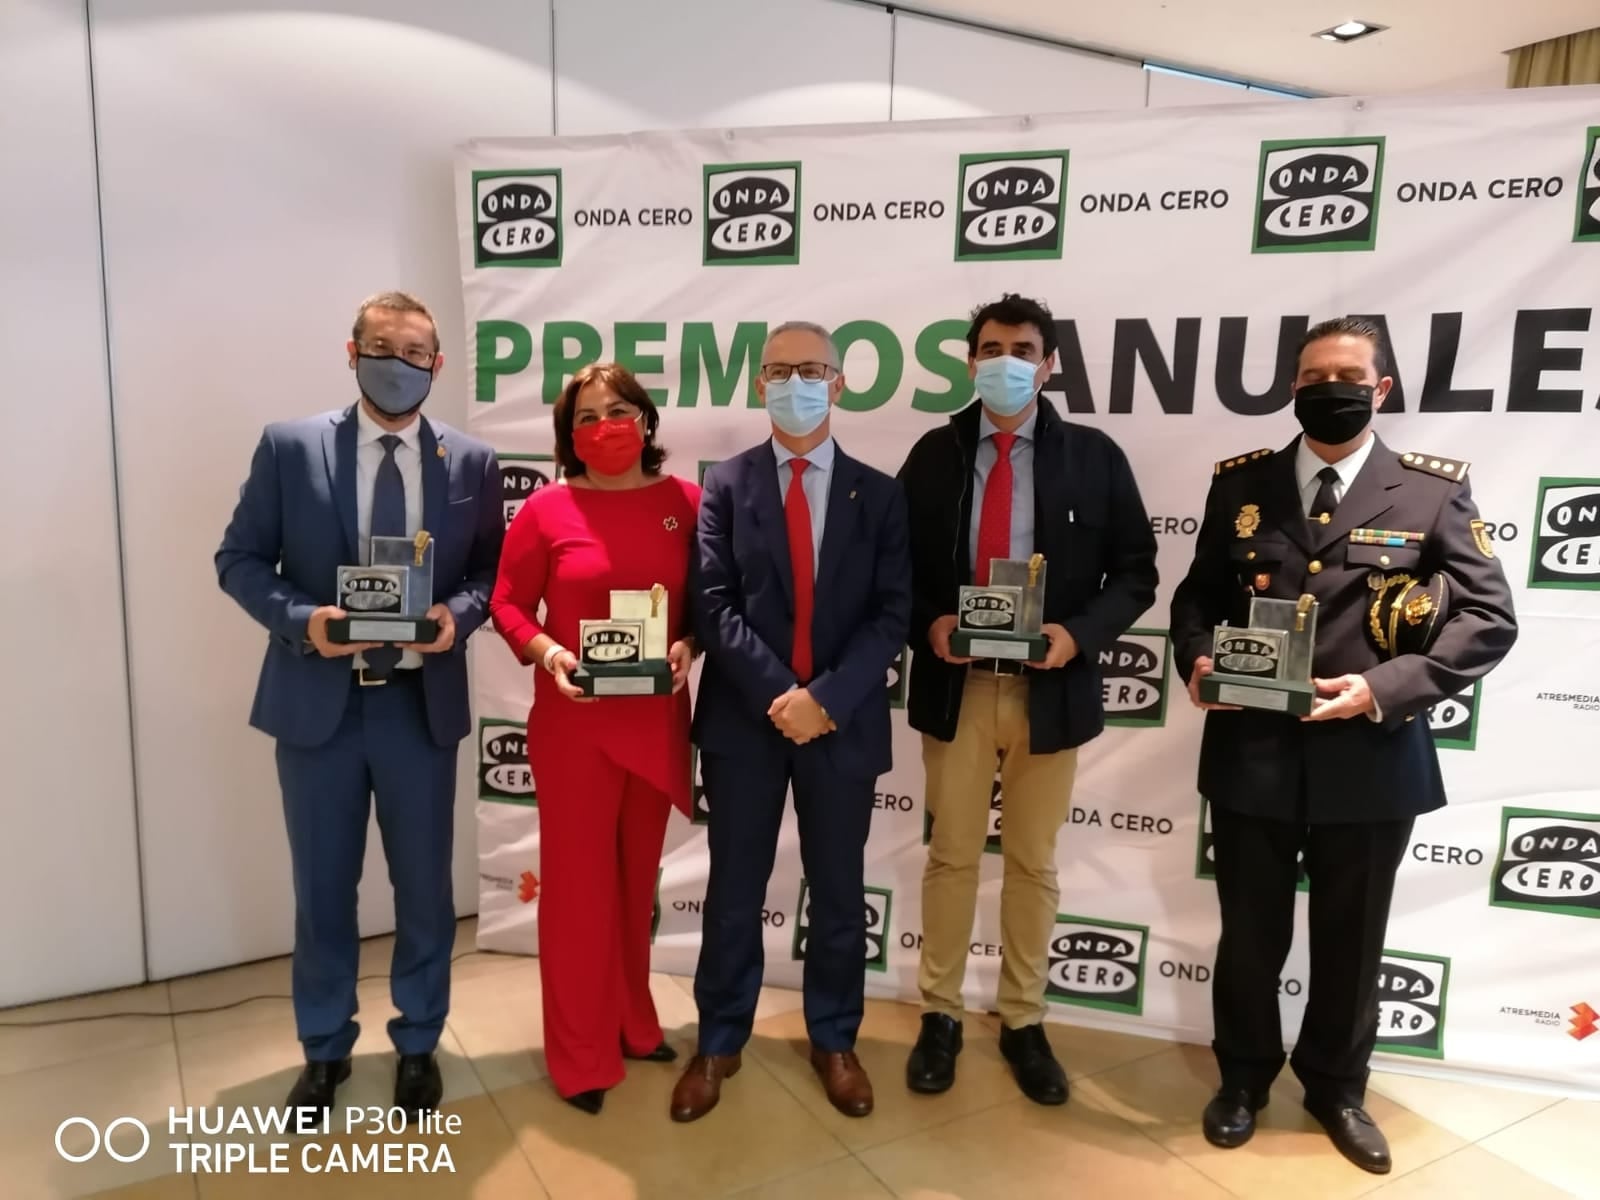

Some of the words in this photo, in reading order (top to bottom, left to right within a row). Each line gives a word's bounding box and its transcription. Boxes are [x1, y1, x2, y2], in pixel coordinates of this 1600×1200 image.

[1278, 165, 1359, 188] ONDA
[719, 187, 783, 208] ONDA
[975, 178, 1047, 200] ONDA
[1397, 181, 1478, 203] ONDA
[1487, 176, 1564, 199] CERO
[487, 193, 546, 213] ONDA
[813, 202, 877, 222] ONDA
[884, 200, 945, 220] CERO
[1079, 192, 1151, 213] ONDA
[1160, 189, 1229, 211] CERO
[573, 208, 631, 227] ONDA
[637, 208, 694, 227] CERO
[977, 214, 1045, 238] CERO
[1279, 203, 1356, 228] CERO
[492, 226, 545, 247] CERO
[722, 222, 782, 243] CERO
[475, 318, 977, 412] PREMOS
[503, 474, 545, 491] NDA
[1151, 516, 1198, 535] ERO
[1557, 505, 1598, 526] ON
[1484, 522, 1518, 541] RO
[1557, 543, 1600, 565] CE
[1098, 650, 1150, 669] NDA
[1102, 684, 1148, 705] ERO
[1536, 692, 1600, 703] ATRESMEDIA
[1573, 703, 1600, 711] RADIO
[494, 770, 531, 787] CER
[873, 793, 913, 812] ERO
[1066, 807, 1102, 827] DA
[1110, 812, 1173, 834] CERO
[1412, 843, 1483, 866] CERO
[1520, 835, 1598, 853] ONDA
[1517, 866, 1594, 891] CERO
[762, 909, 785, 927] RO
[970, 942, 1003, 956] CE
[1058, 938, 1127, 954] ONDA
[1061, 963, 1125, 987] CERO
[1159, 960, 1211, 982] OND
[1378, 974, 1425, 993] DA
[1378, 1007, 1423, 1030] RO
[1500, 1006, 1560, 1019] ATRESMEDIA
